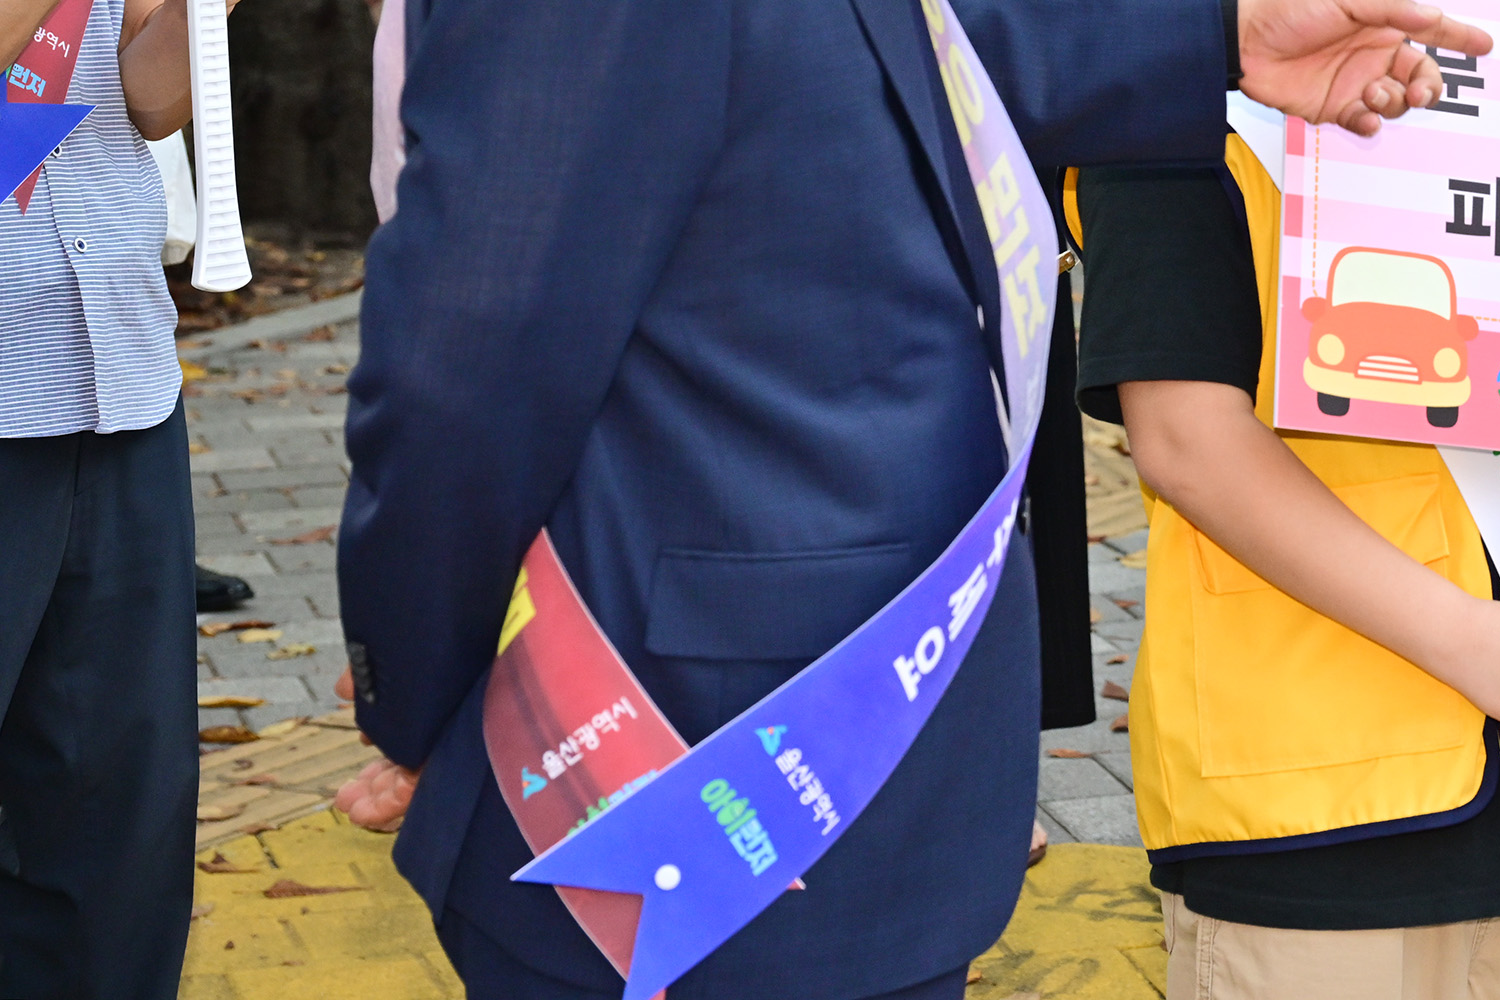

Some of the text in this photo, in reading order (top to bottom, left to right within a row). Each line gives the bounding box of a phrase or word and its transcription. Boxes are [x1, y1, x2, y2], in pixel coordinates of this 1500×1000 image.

[8, 63, 47, 97] 먼저
[34, 27, 70, 58] 광역시
[1408, 40, 1485, 117] 문
[541, 695, 639, 780] 울산광역시
[774, 747, 842, 837] 울산광역시
